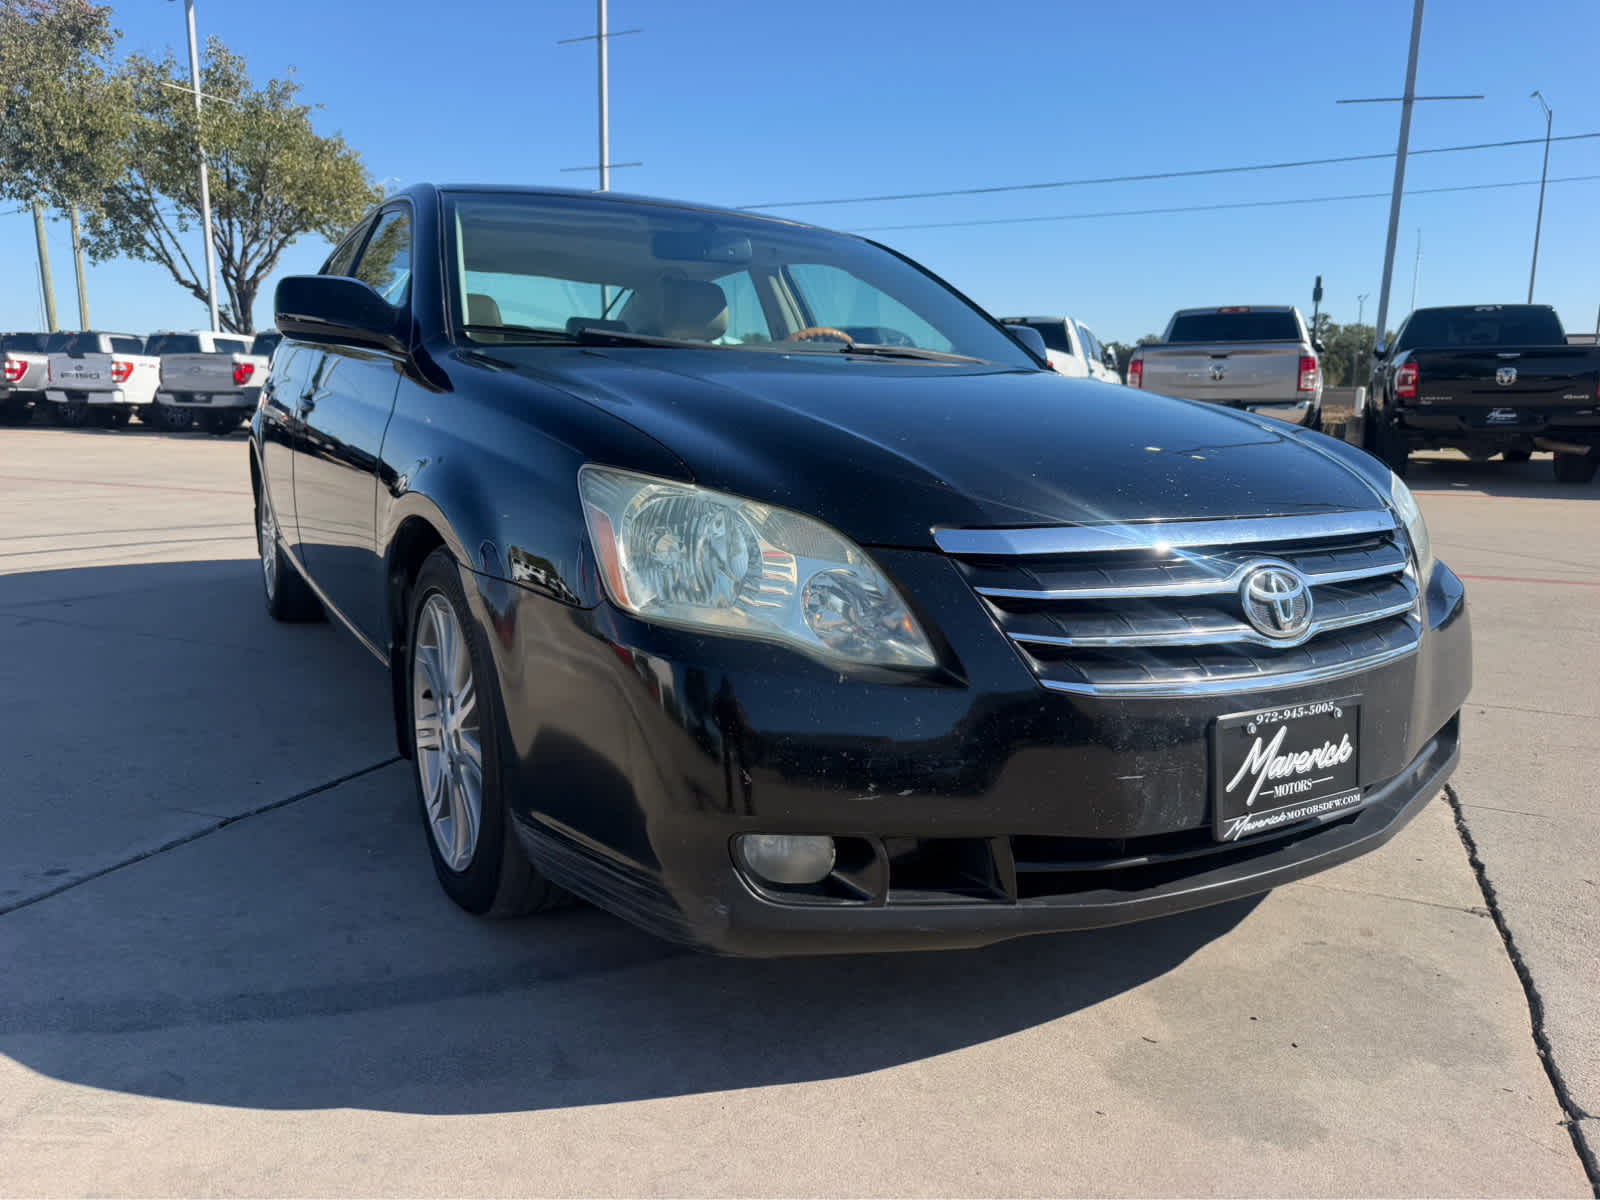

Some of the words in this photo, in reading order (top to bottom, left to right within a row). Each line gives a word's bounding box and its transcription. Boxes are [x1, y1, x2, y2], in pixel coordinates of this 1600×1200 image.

[1256, 701, 1334, 725] 972-945-5005
[1225, 725, 1353, 806] Maverick
[1273, 778, 1313, 798] MOTORS
